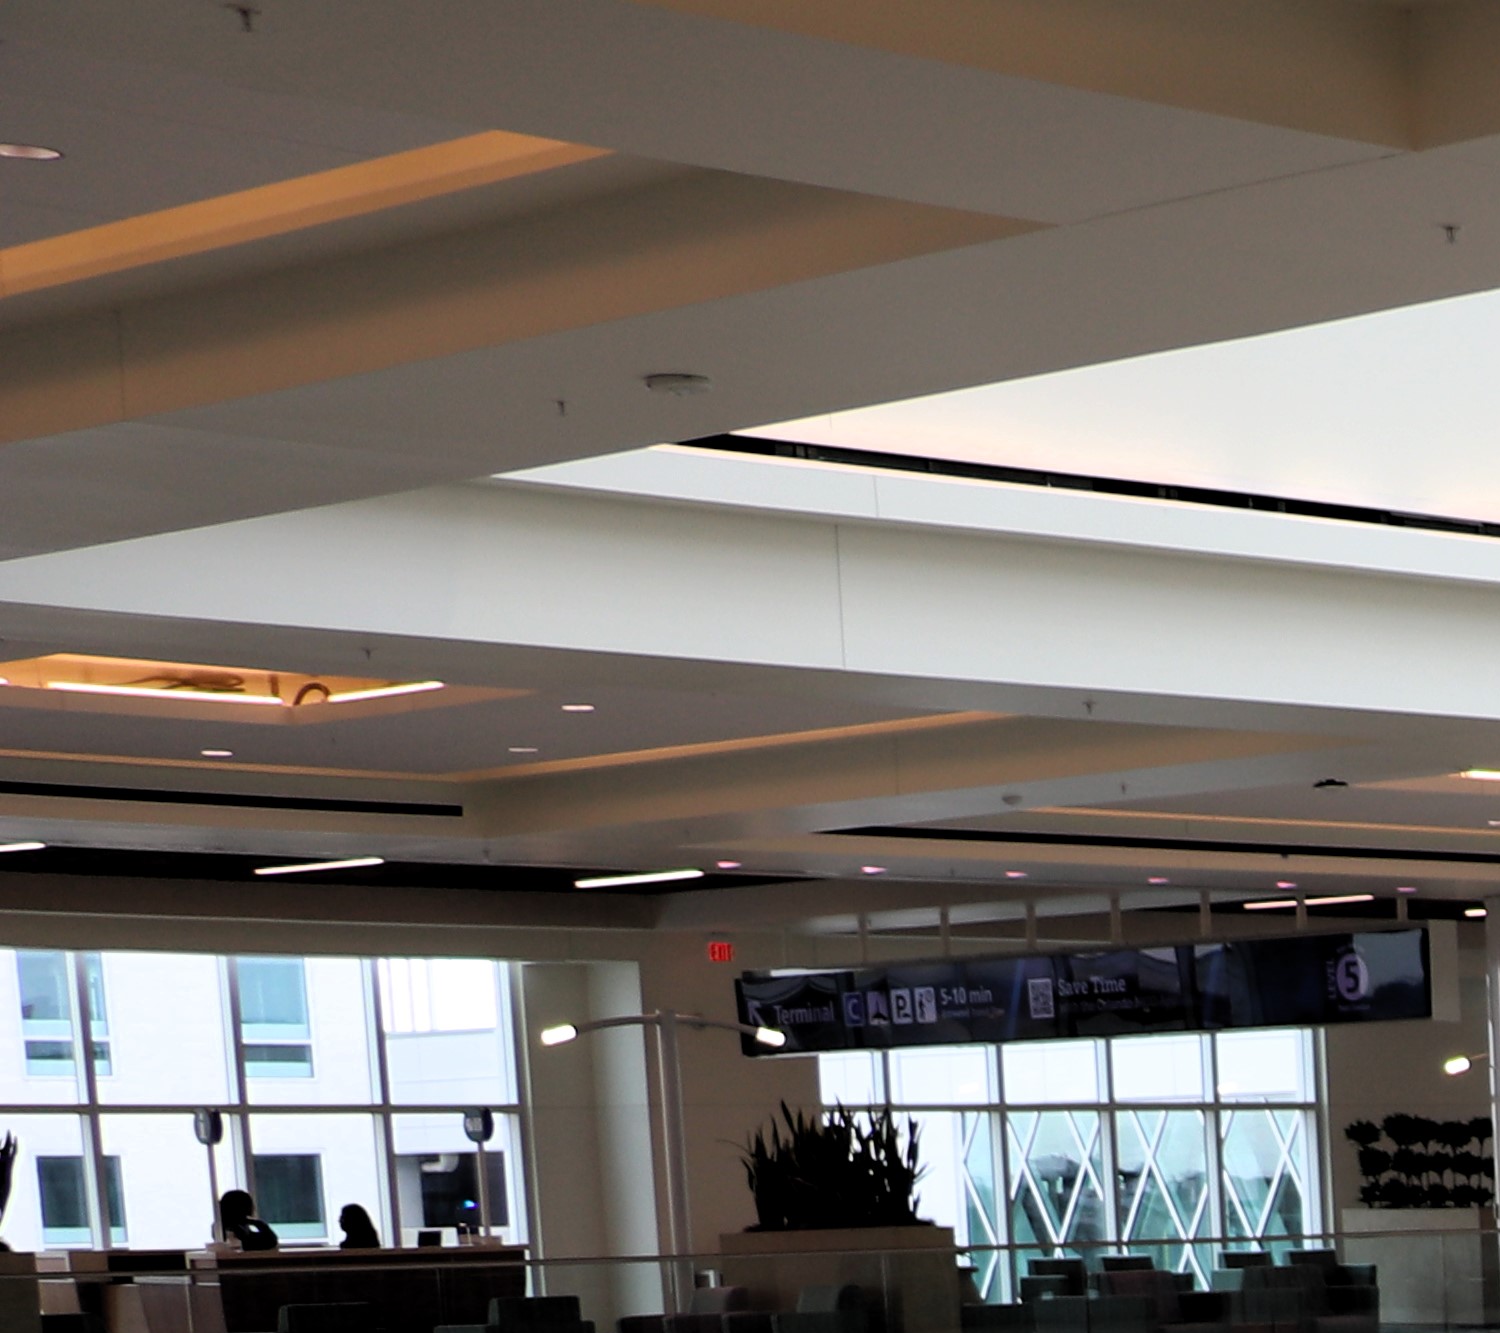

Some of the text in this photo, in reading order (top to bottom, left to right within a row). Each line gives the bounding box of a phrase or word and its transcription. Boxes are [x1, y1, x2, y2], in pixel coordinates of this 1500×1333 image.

[1058, 975, 1126, 997] Save Time
[1345, 961, 1359, 992] 5
[941, 986, 993, 1005] 5-10 min
[773, 1001, 835, 1026] Terminal
